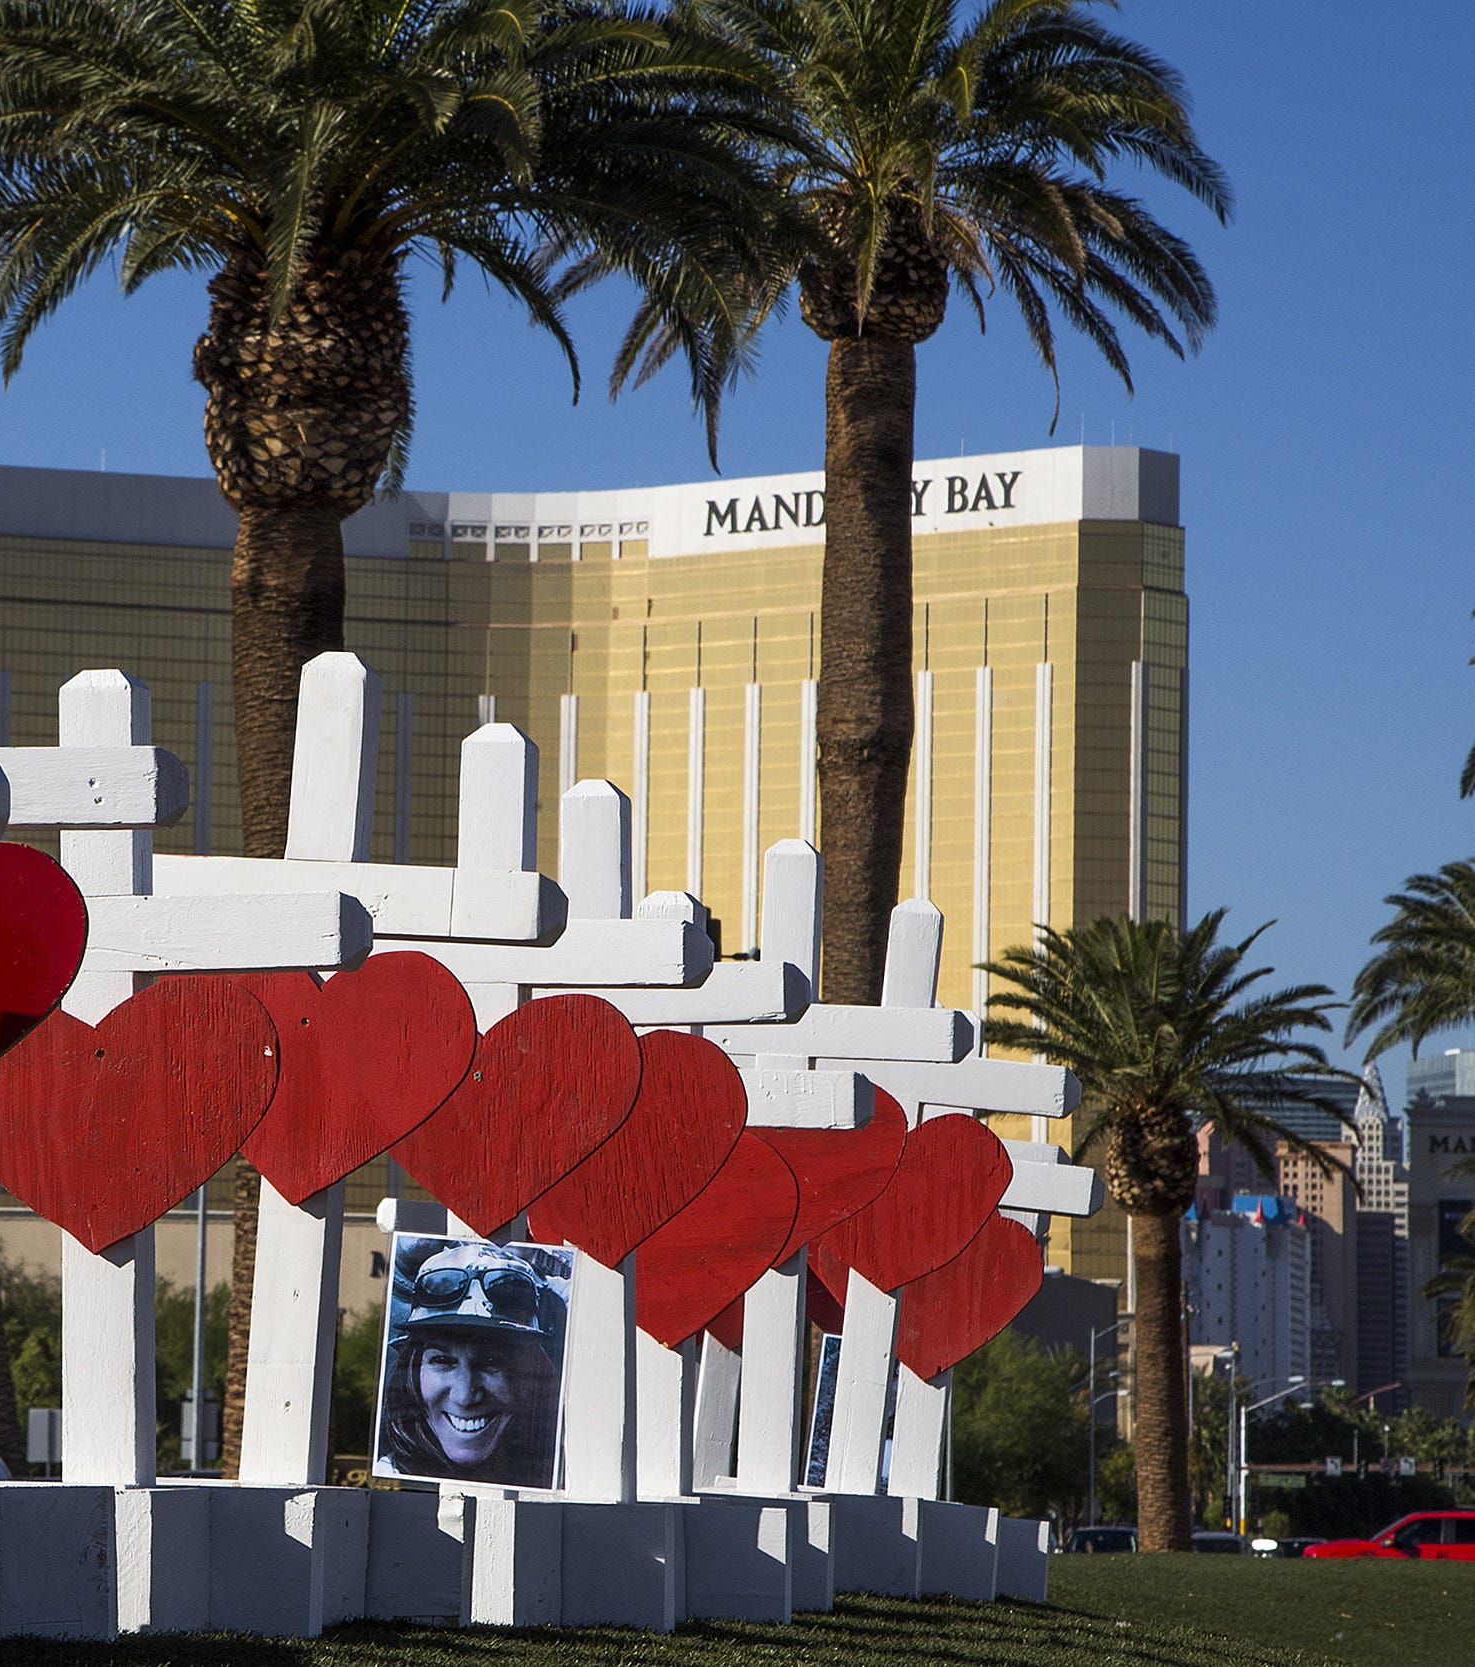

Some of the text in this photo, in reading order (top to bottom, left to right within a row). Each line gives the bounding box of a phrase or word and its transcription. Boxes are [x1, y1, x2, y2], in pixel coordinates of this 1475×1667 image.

[703, 471, 1023, 536] MANDY BAY
[1428, 1135, 1475, 1153] MA
